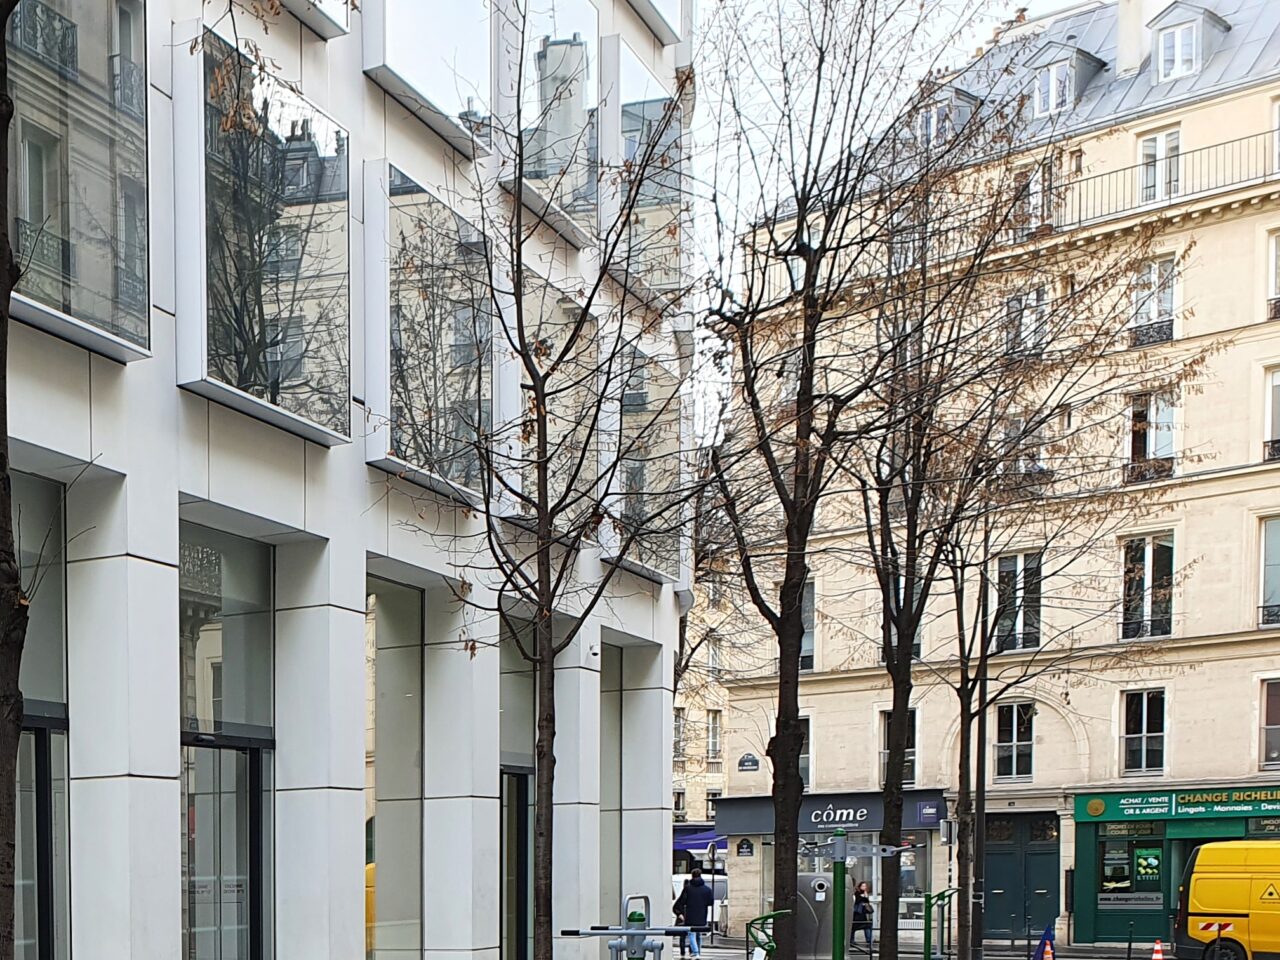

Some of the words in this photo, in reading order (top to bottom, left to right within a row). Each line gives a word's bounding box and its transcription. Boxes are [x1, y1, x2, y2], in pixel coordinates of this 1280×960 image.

[1177, 793, 1228, 803] CHANGE
[811, 803, 868, 822] côme
[1177, 805, 1206, 814] Lingots
[1213, 804, 1253, 812] Monnaies
[1260, 802, 1280, 811] Devi
